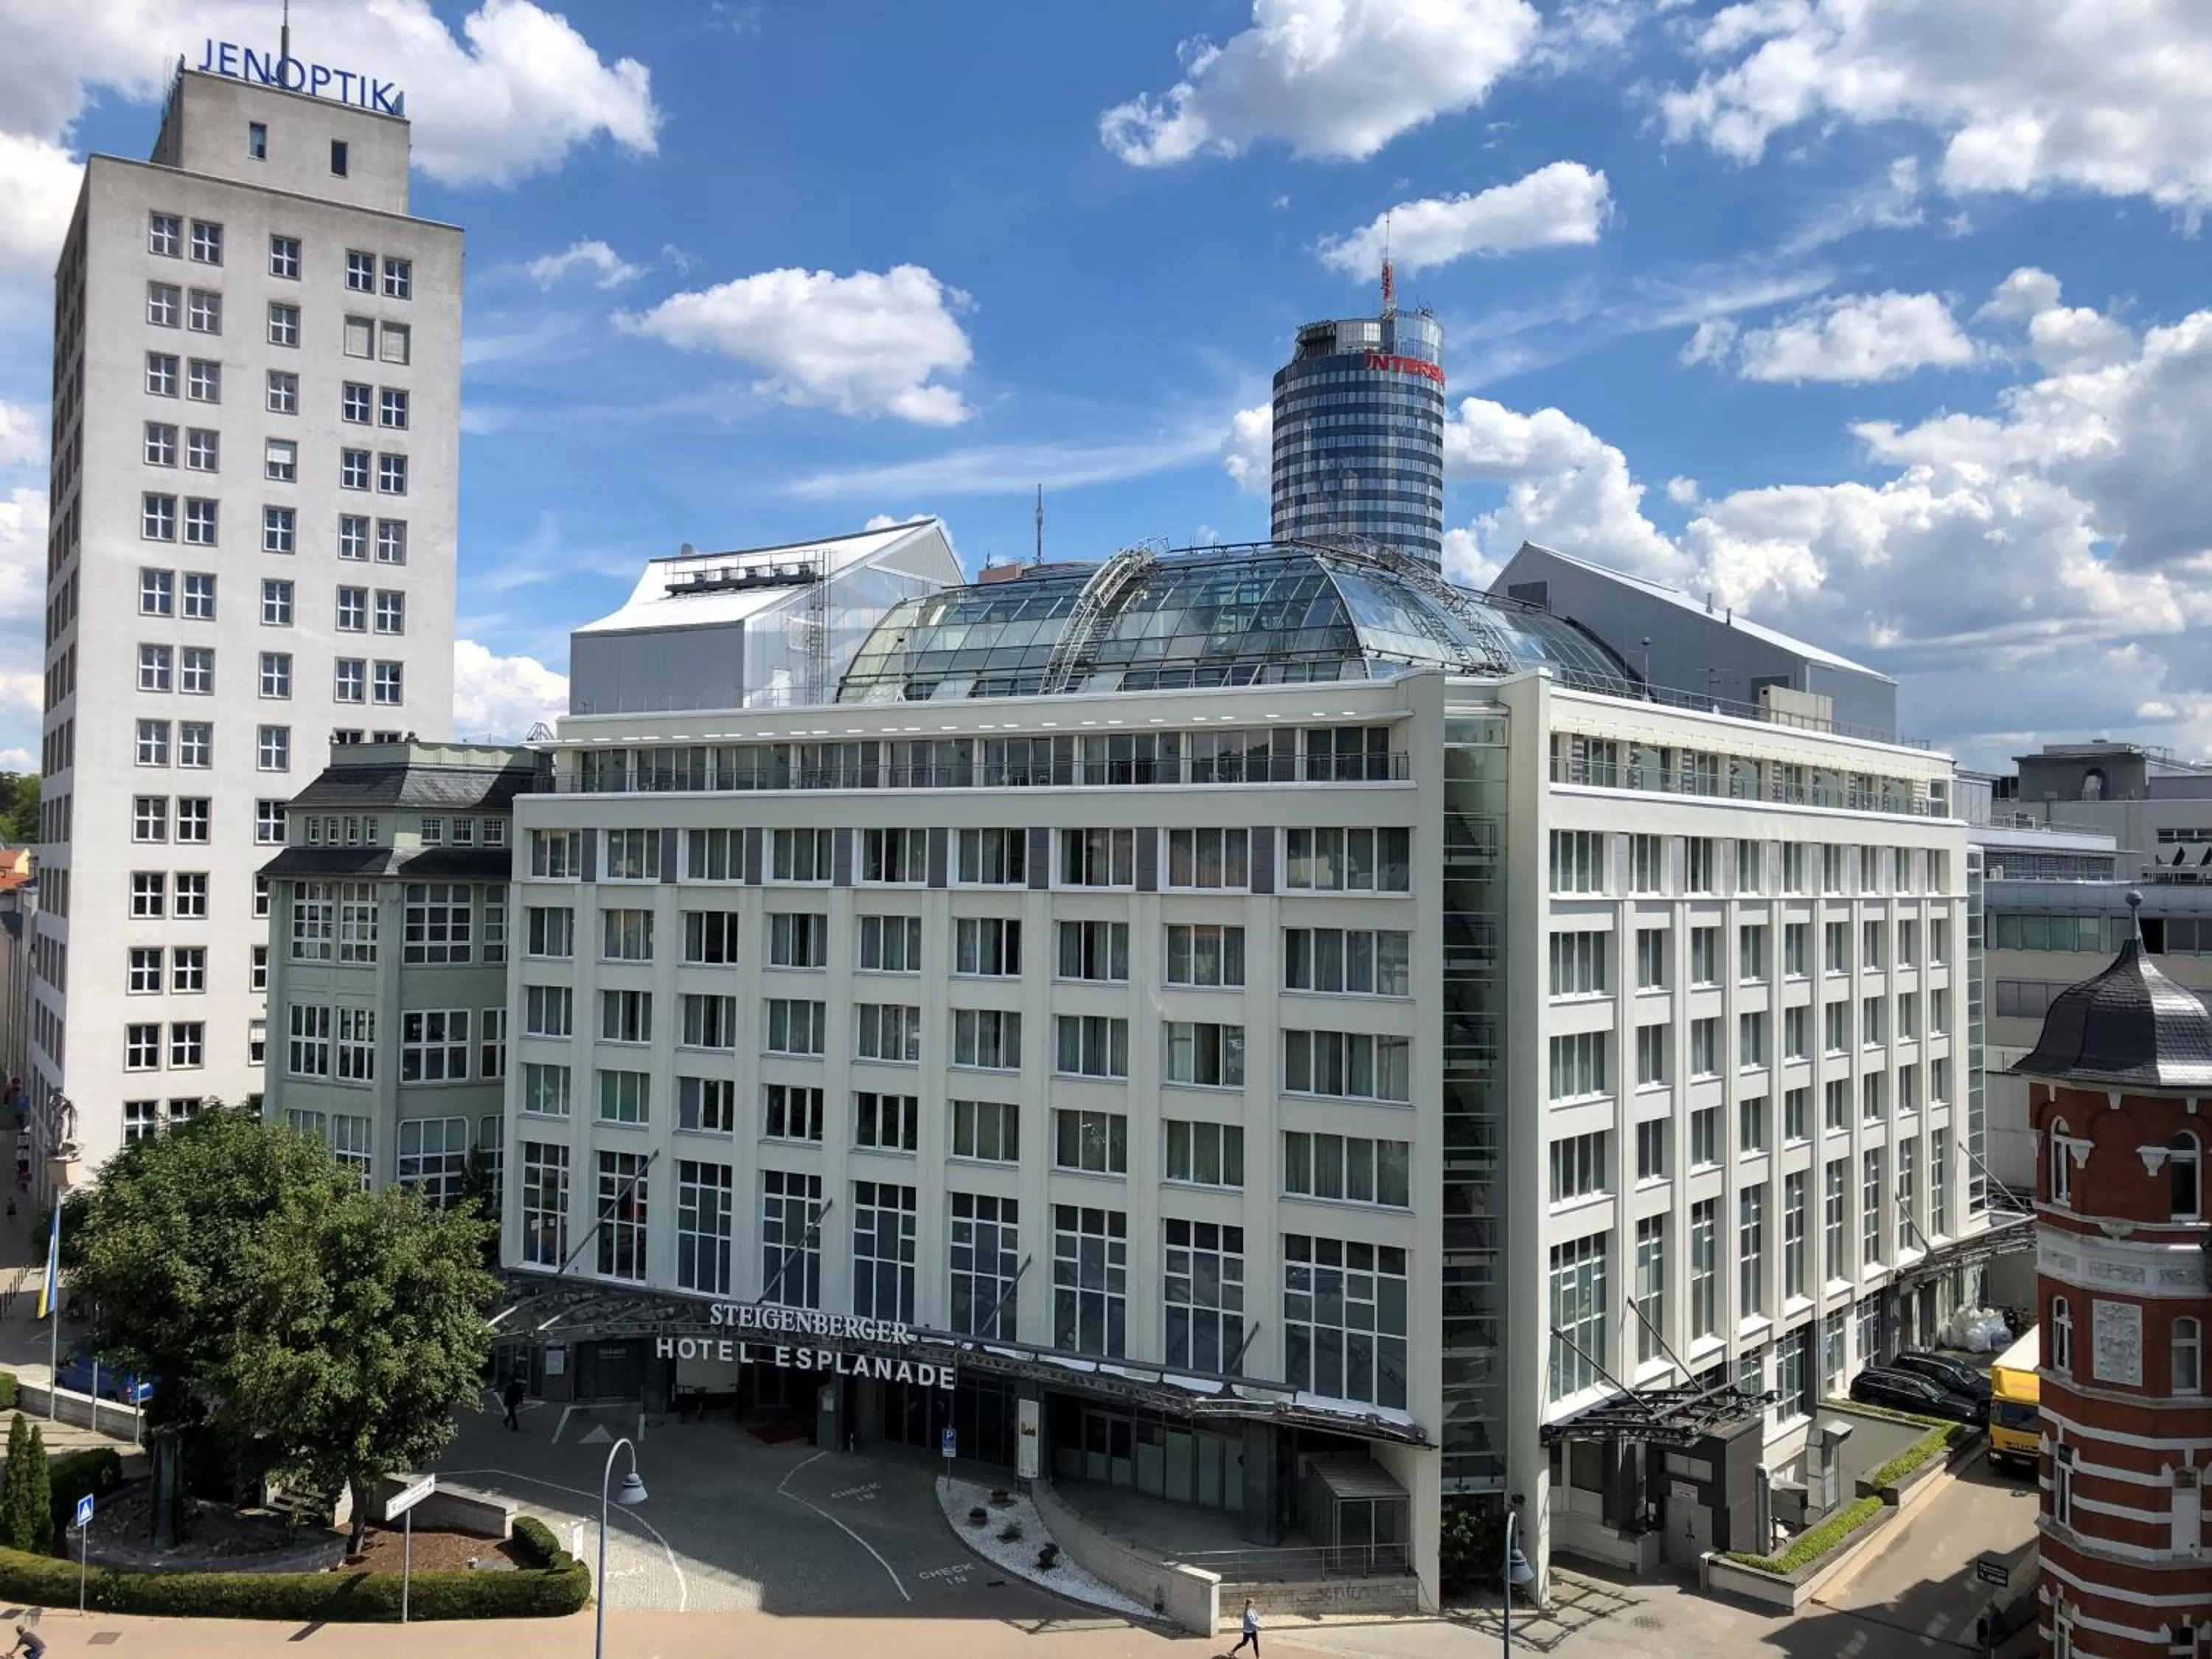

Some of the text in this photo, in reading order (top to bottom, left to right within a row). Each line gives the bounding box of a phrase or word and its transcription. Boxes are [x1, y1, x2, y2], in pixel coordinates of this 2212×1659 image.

[198, 38, 395, 115] JENOPTIK
[710, 1304, 911, 1345] STEIGENBERGER
[655, 1337, 956, 1390] HOTEL ESPLANADE
